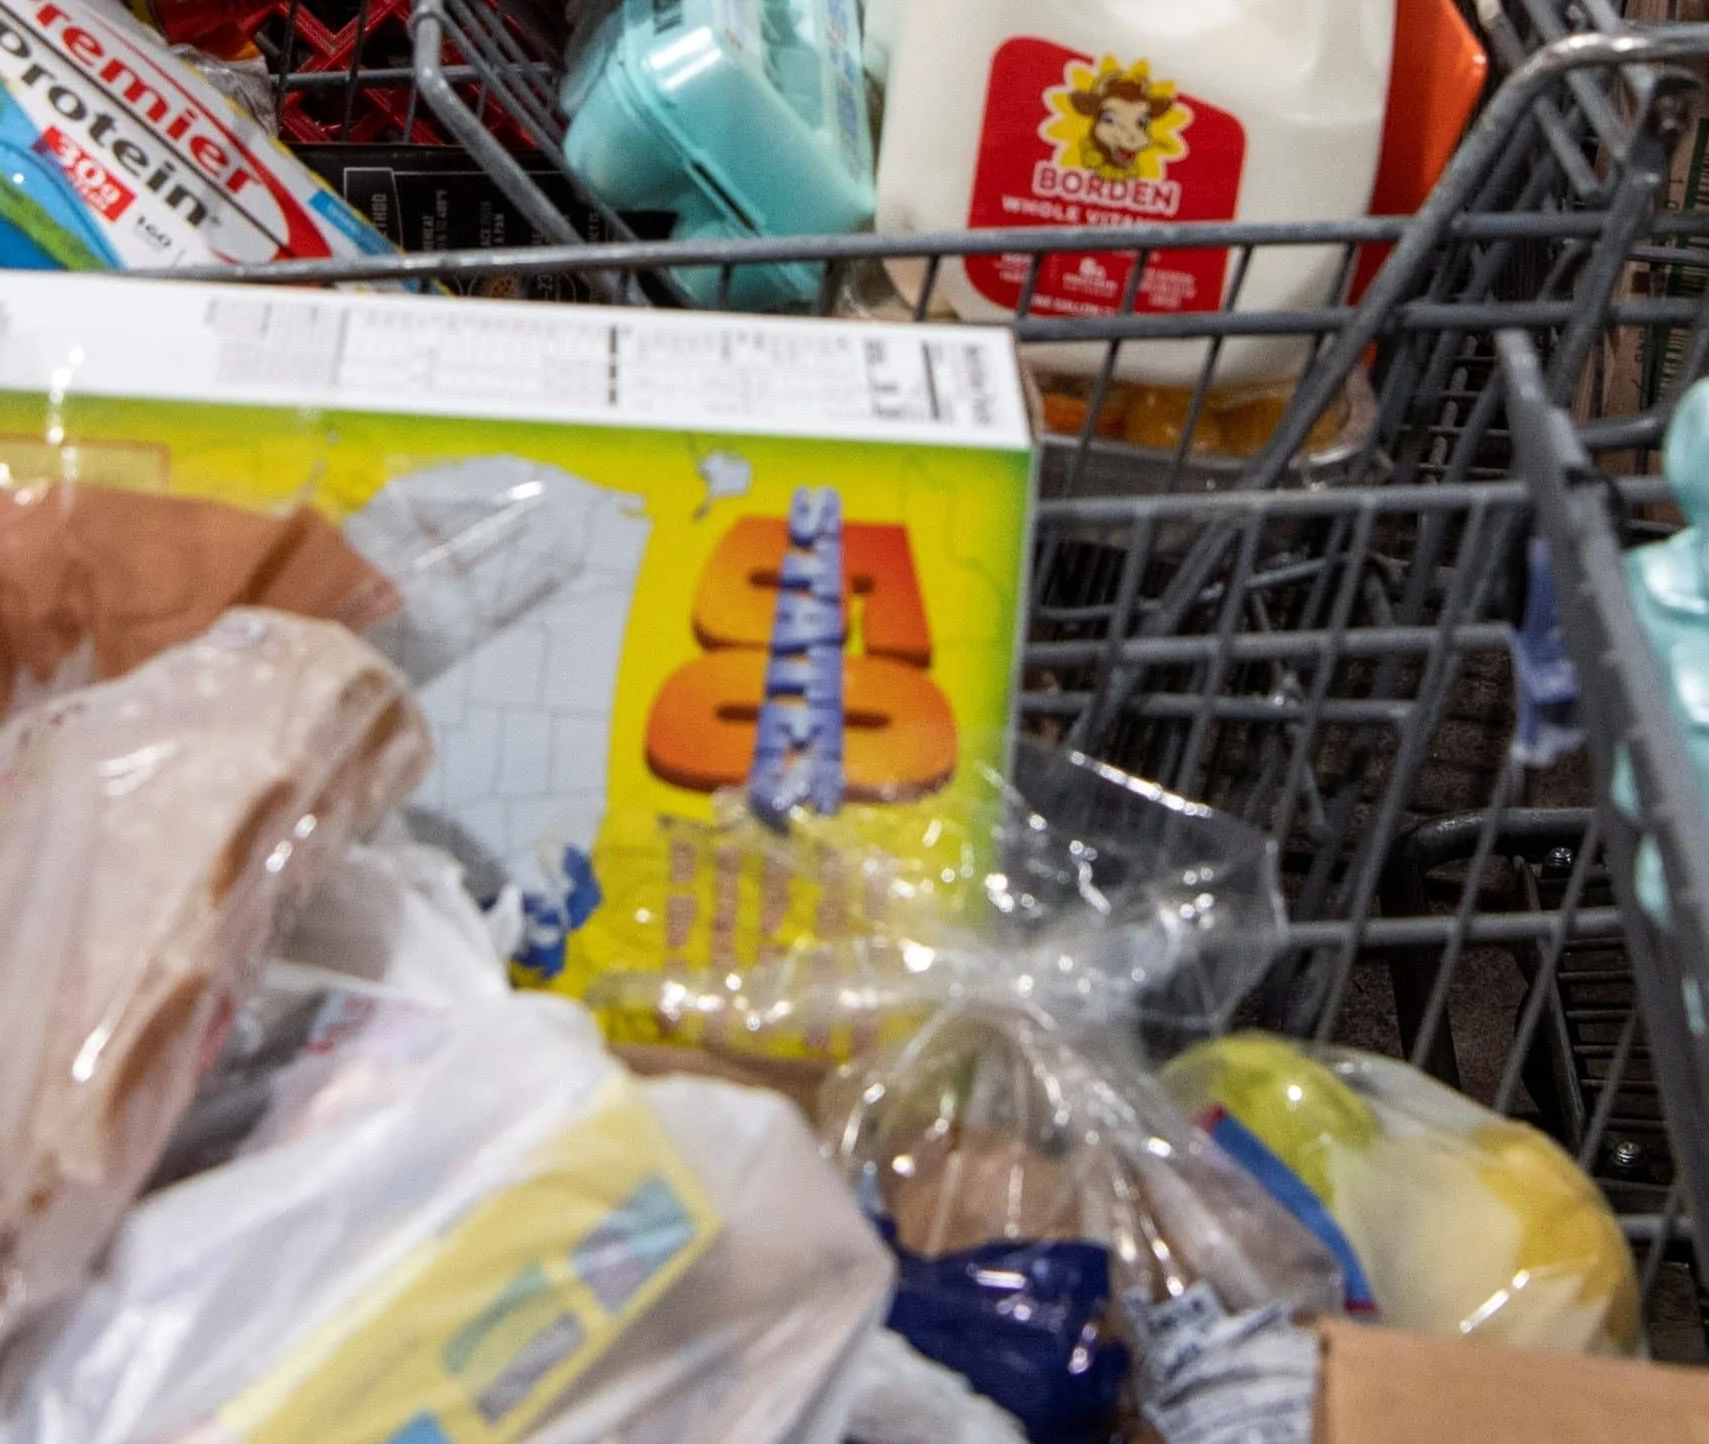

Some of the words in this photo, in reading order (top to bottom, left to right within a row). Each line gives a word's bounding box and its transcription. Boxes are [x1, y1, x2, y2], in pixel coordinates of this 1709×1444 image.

[54, 138, 122, 207] 30g
[1034, 163, 1183, 216] BORDEN
[1002, 195, 1081, 223] WHOLE
